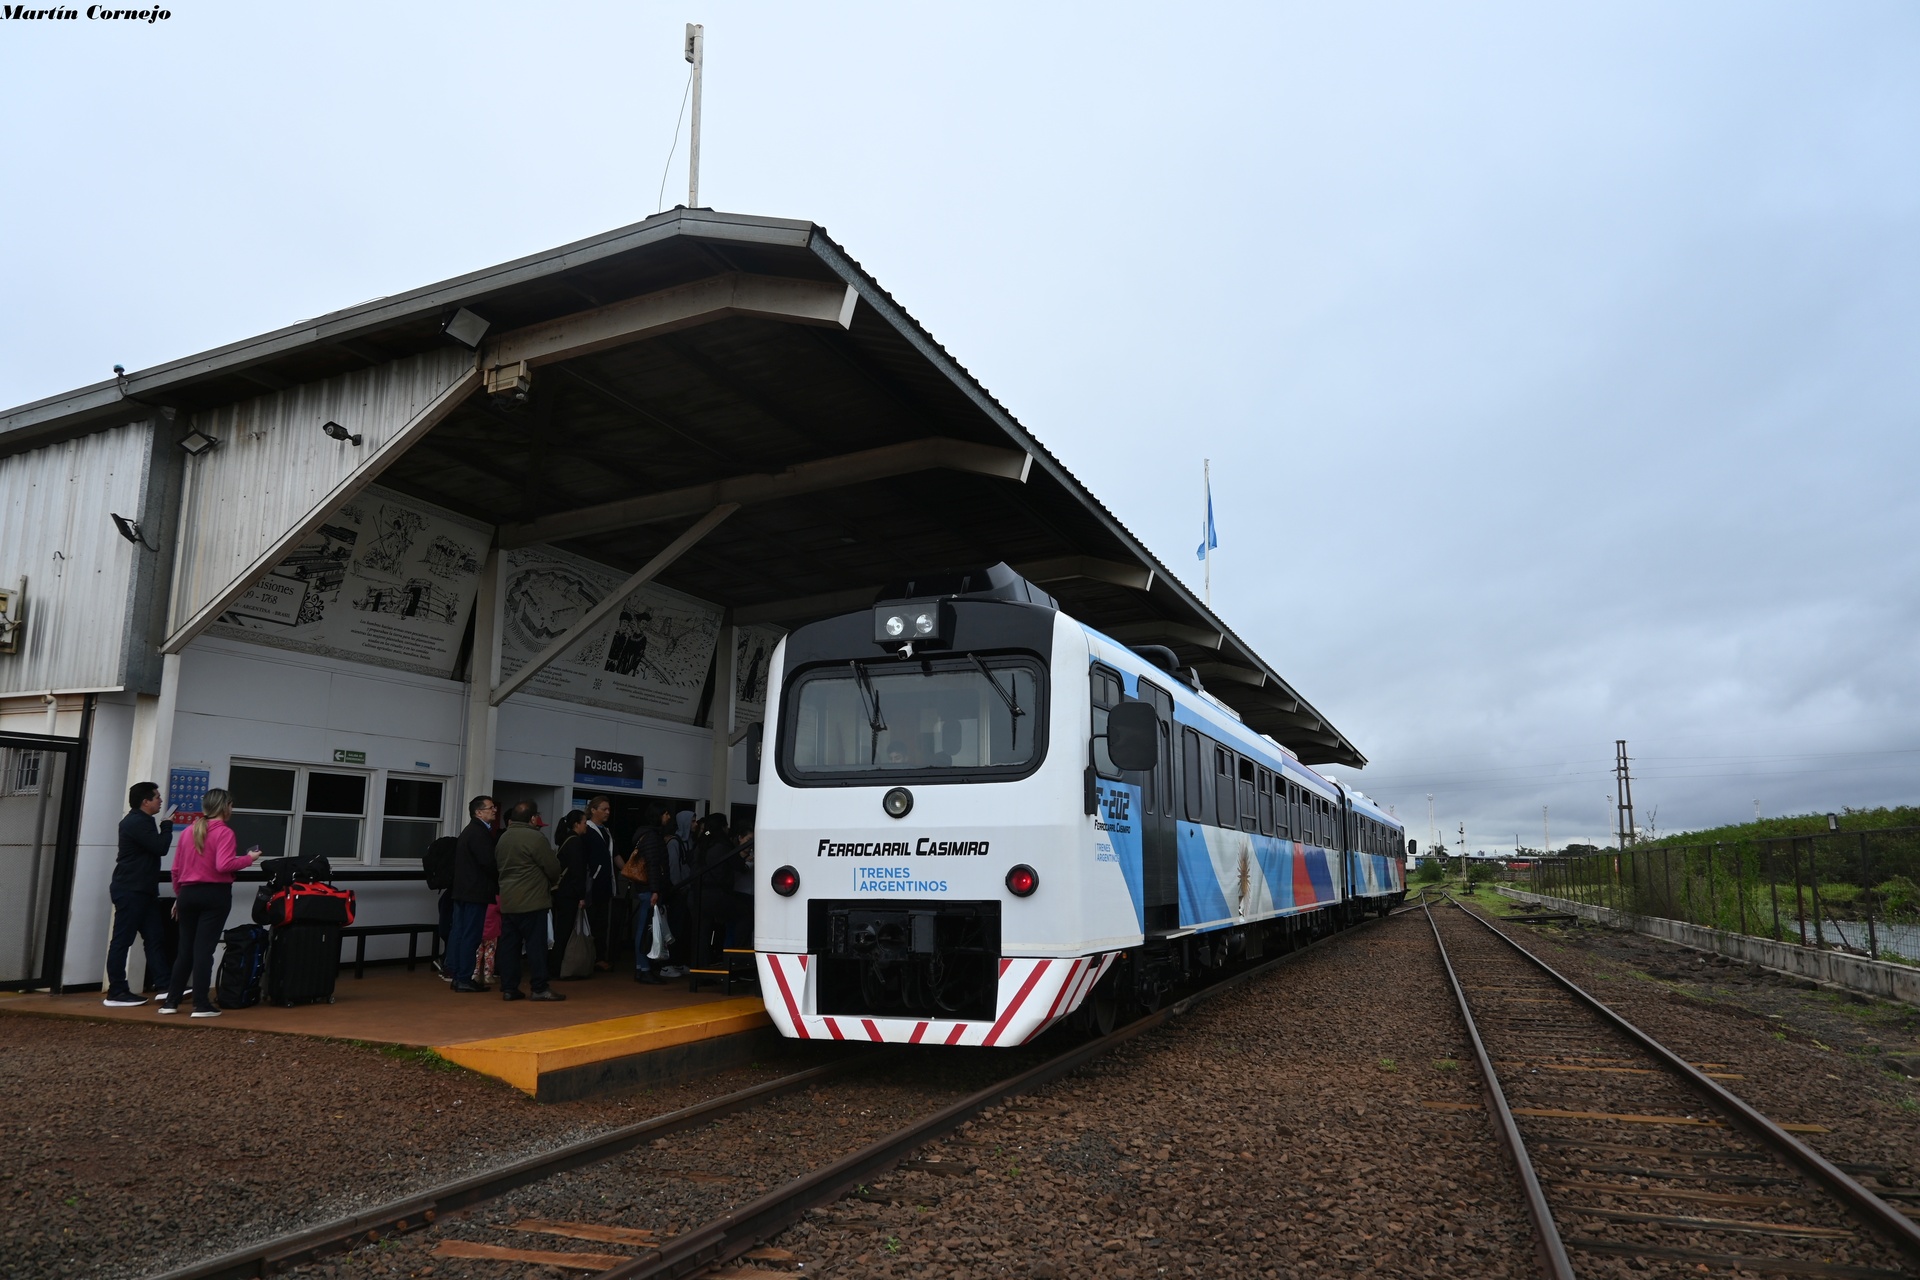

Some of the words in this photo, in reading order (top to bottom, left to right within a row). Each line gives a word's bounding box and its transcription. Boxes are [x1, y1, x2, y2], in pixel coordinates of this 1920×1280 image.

[261, 593, 278, 605] 1768
[242, 604, 271, 613] ARGENTINA
[584, 755, 623, 772] Posadas
[817, 839, 911, 857] FERROCARRIL
[915, 838, 990, 856] CASIMIRO
[859, 867, 911, 878] TRENES
[859, 880, 948, 892] ARGENTINOS
